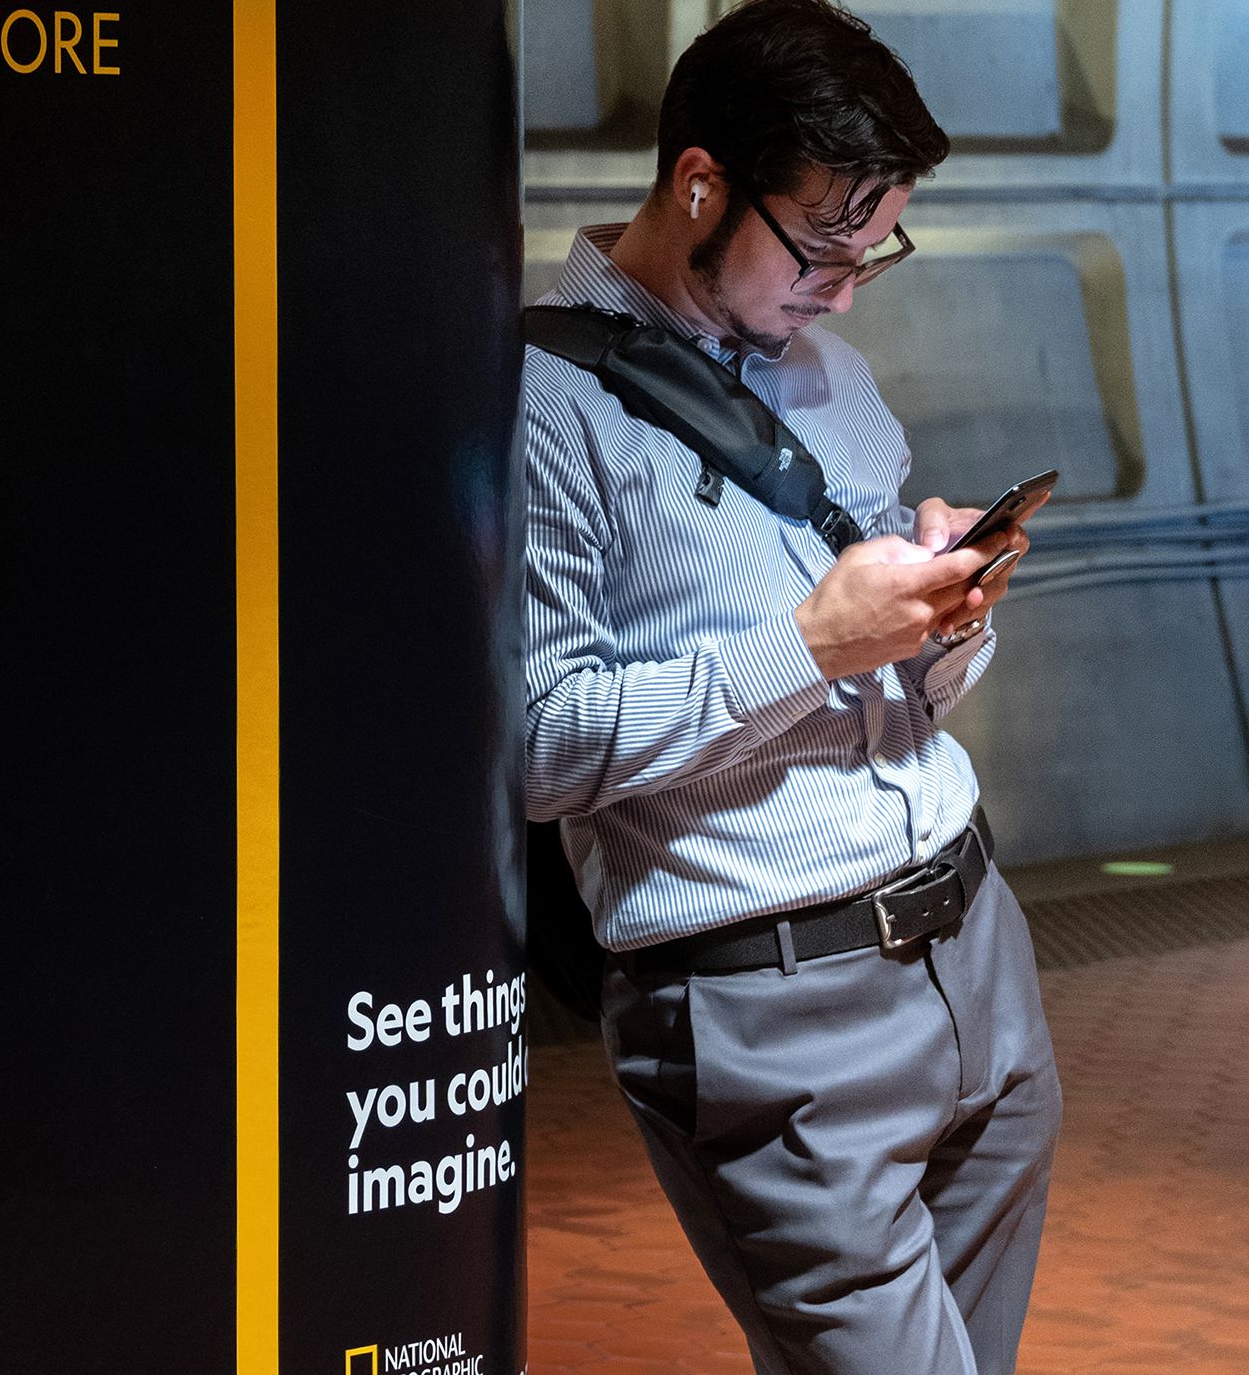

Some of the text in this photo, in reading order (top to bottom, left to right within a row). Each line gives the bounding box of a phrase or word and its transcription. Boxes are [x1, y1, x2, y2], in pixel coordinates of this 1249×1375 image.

[347, 969, 526, 1052] See things
[346, 1079, 436, 1150] you
[447, 1034, 523, 1116] could
[348, 1134, 516, 1215] imagine.
[384, 1332, 466, 1373] NATIONAL
